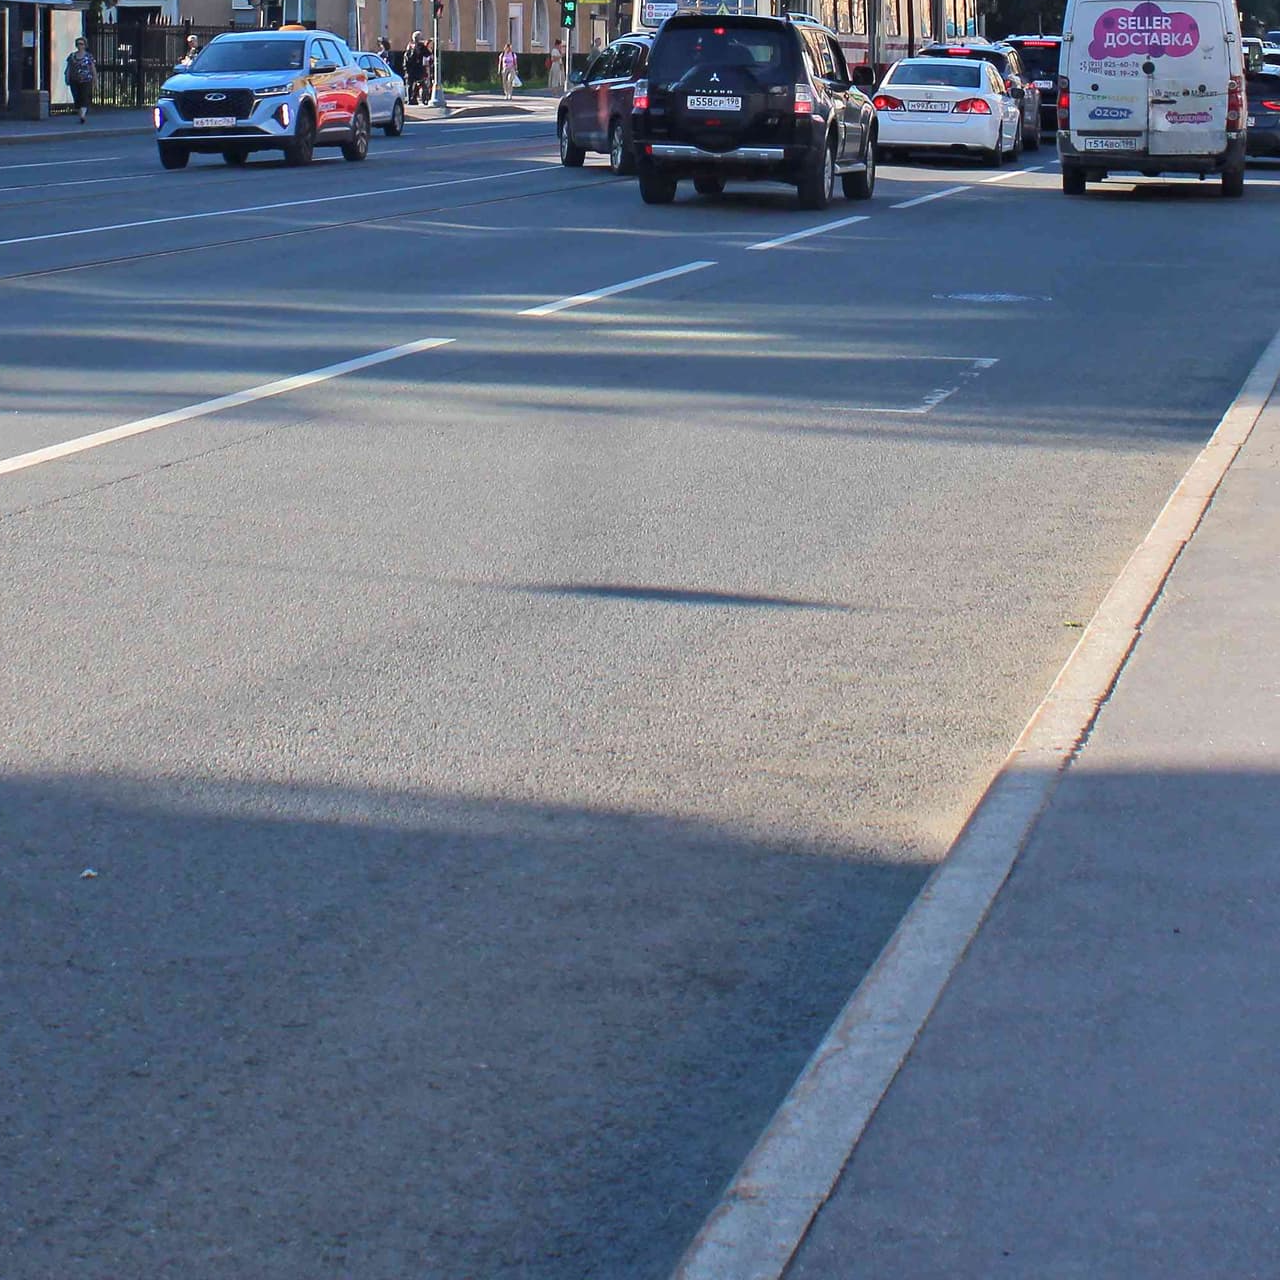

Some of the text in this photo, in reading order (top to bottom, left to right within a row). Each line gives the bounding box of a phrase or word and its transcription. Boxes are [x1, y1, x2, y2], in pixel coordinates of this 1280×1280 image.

[1117, 16, 1172, 30] SELLER
[1104, 32, 1193, 48] ДОСТАВКА
[1094, 109, 1129, 118] OZON
